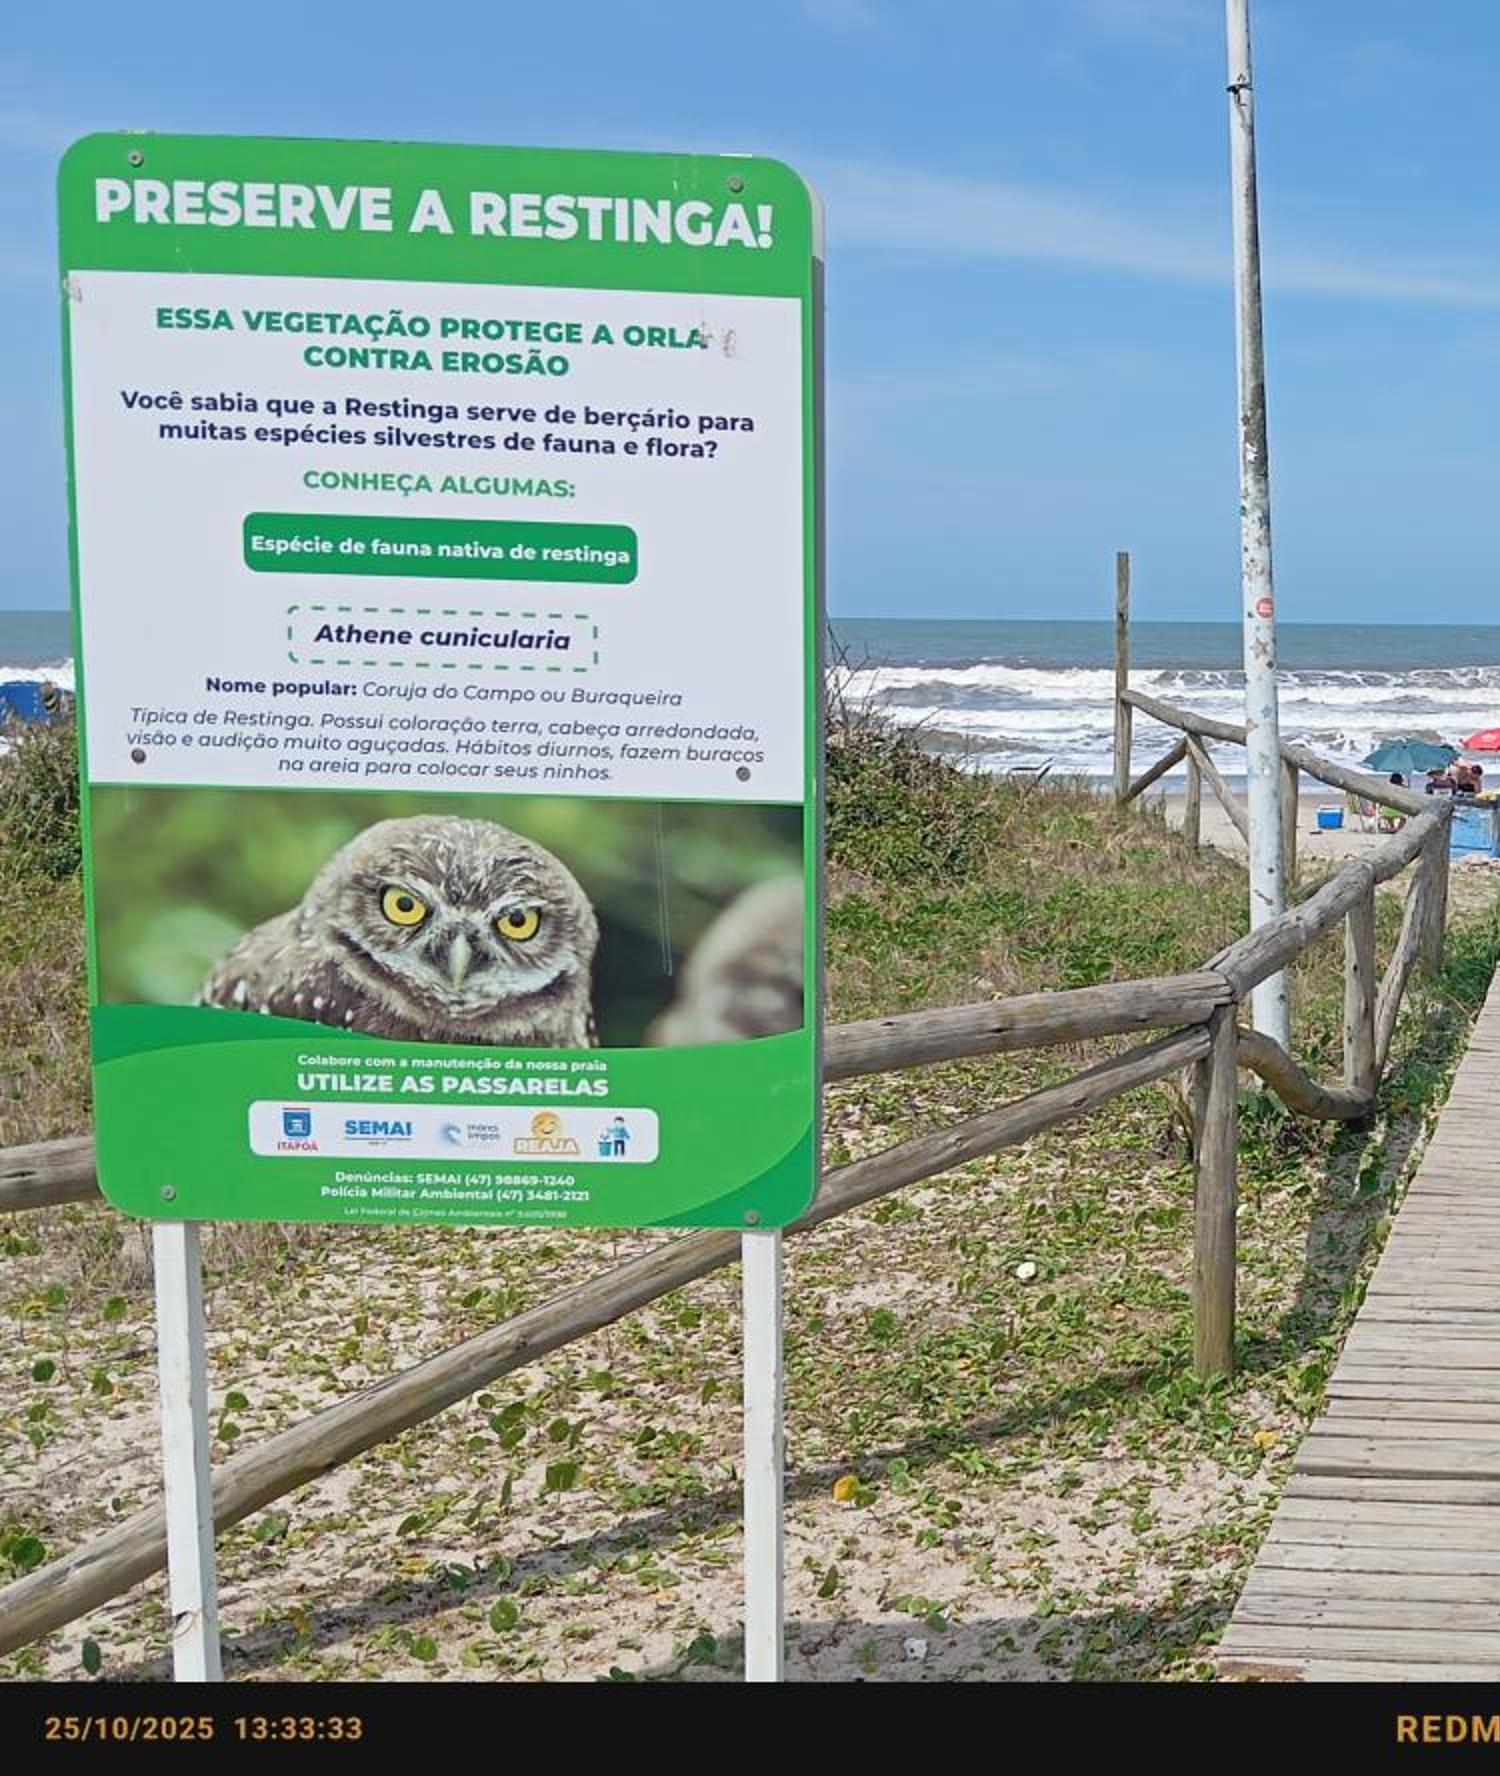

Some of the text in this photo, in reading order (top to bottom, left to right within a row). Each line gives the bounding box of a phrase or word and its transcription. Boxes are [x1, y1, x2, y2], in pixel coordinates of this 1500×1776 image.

[96, 178, 772, 248] PRESERVE A RESTINGA!
[157, 308, 707, 348] ESSA VEGETAÇÃO PROTEGE A ORLA
[304, 346, 568, 376] CONTRA EROSÃO
[121, 391, 753, 434] Você sabia que a Restinga serve de berçário para
[160, 420, 717, 458] muitas espécies silvestres de fauna e flora?
[304, 471, 574, 497] CONHEÇA ALGUMAS:
[252, 536, 629, 566] Espécie de fauna nativa de restinga
[315, 624, 570, 649] Athene cunicularia
[207, 678, 682, 707] Nome popular: Coruja do Campo ou Buraqueira
[132, 708, 758, 742] Típica de Restinga. Possui coloração terra, cabeça arredondada,
[128, 730, 764, 762] visão e audição muito aguçadas. Hábitos diurnos, fazem buracos
[279, 758, 610, 780] na areia para colocar seus ninhos.
[298, 1056, 360, 1066] Colabore
[365, 1058, 395, 1067] com
[412, 1058, 501, 1070] manutenção
[505, 1059, 522, 1068] da
[526, 1062, 567, 1070] nossa
[571, 1060, 607, 1072] praia
[298, 1074, 608, 1096] UTILIZE AS PASSARELAS
[346, 1120, 411, 1135] SEMAI
[513, 1137, 580, 1155] REAJA
[336, 1172, 413, 1182] Denúncias:
[417, 1174, 461, 1184] SEMAI
[465, 1175, 491, 1186] (47)
[321, 1186, 367, 1197] Polícia
[372, 1187, 416, 1198] Militar
[420, 1188, 493, 1200] Ambiental
[497, 1190, 523, 1201] (47)
